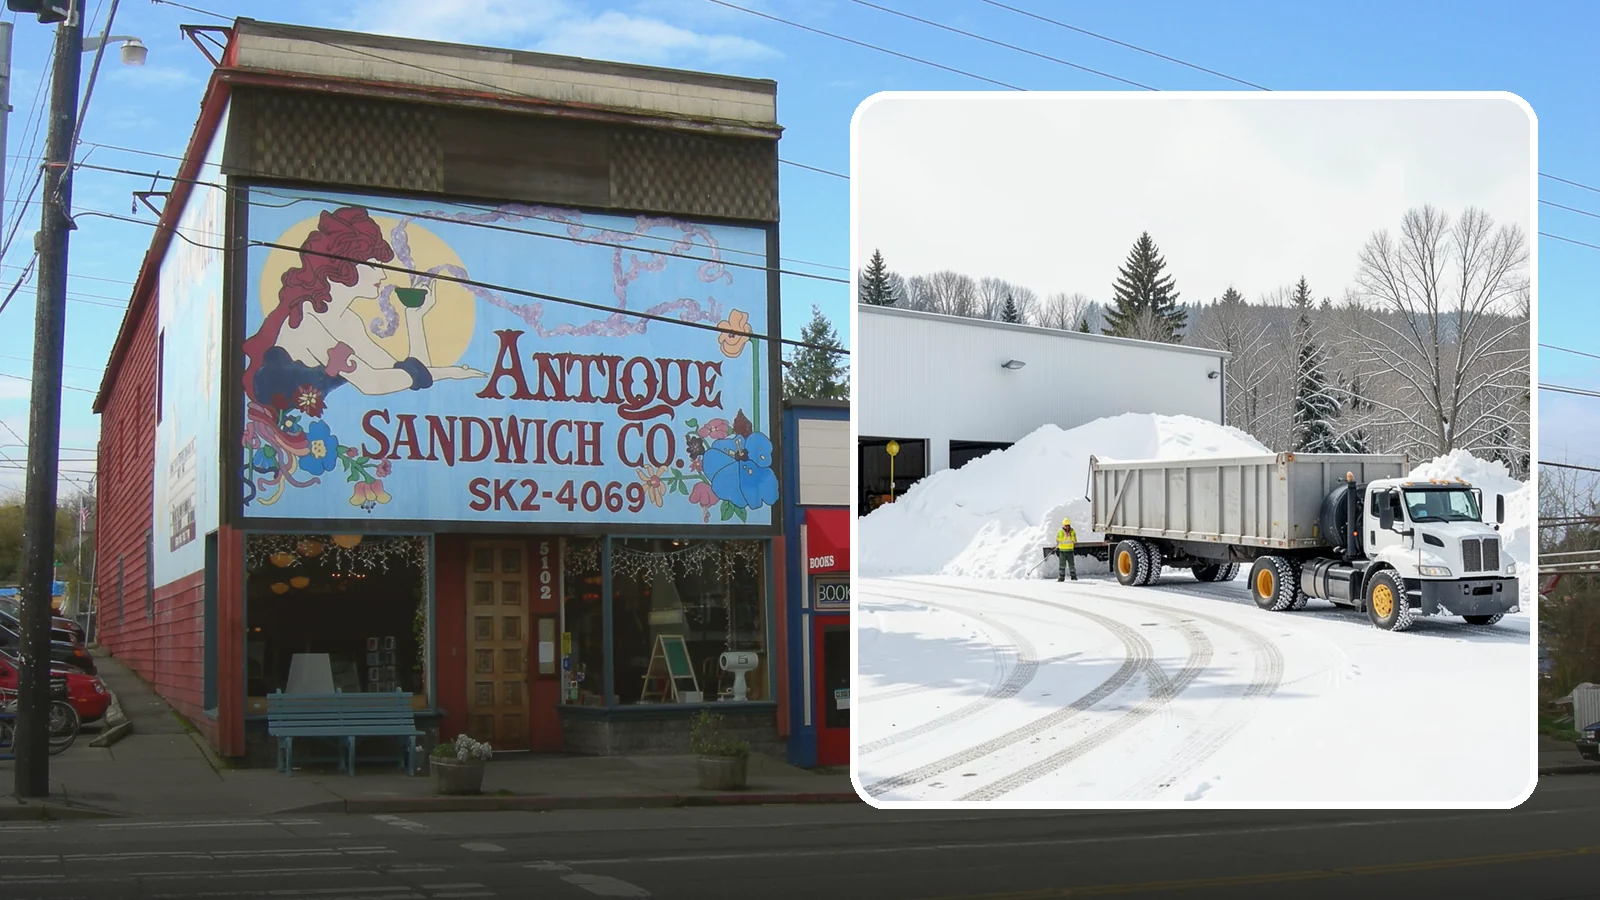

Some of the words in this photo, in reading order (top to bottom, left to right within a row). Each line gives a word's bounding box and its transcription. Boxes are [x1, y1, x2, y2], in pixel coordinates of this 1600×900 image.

[475, 329, 724, 421] ANTIQUE
[361, 408, 605, 467] SANDWICH
[617, 422, 684, 469] CO.
[467, 477, 646, 513] SK2-4069
[539, 541, 552, 600] 5102
[809, 555, 835, 569] BOOKS
